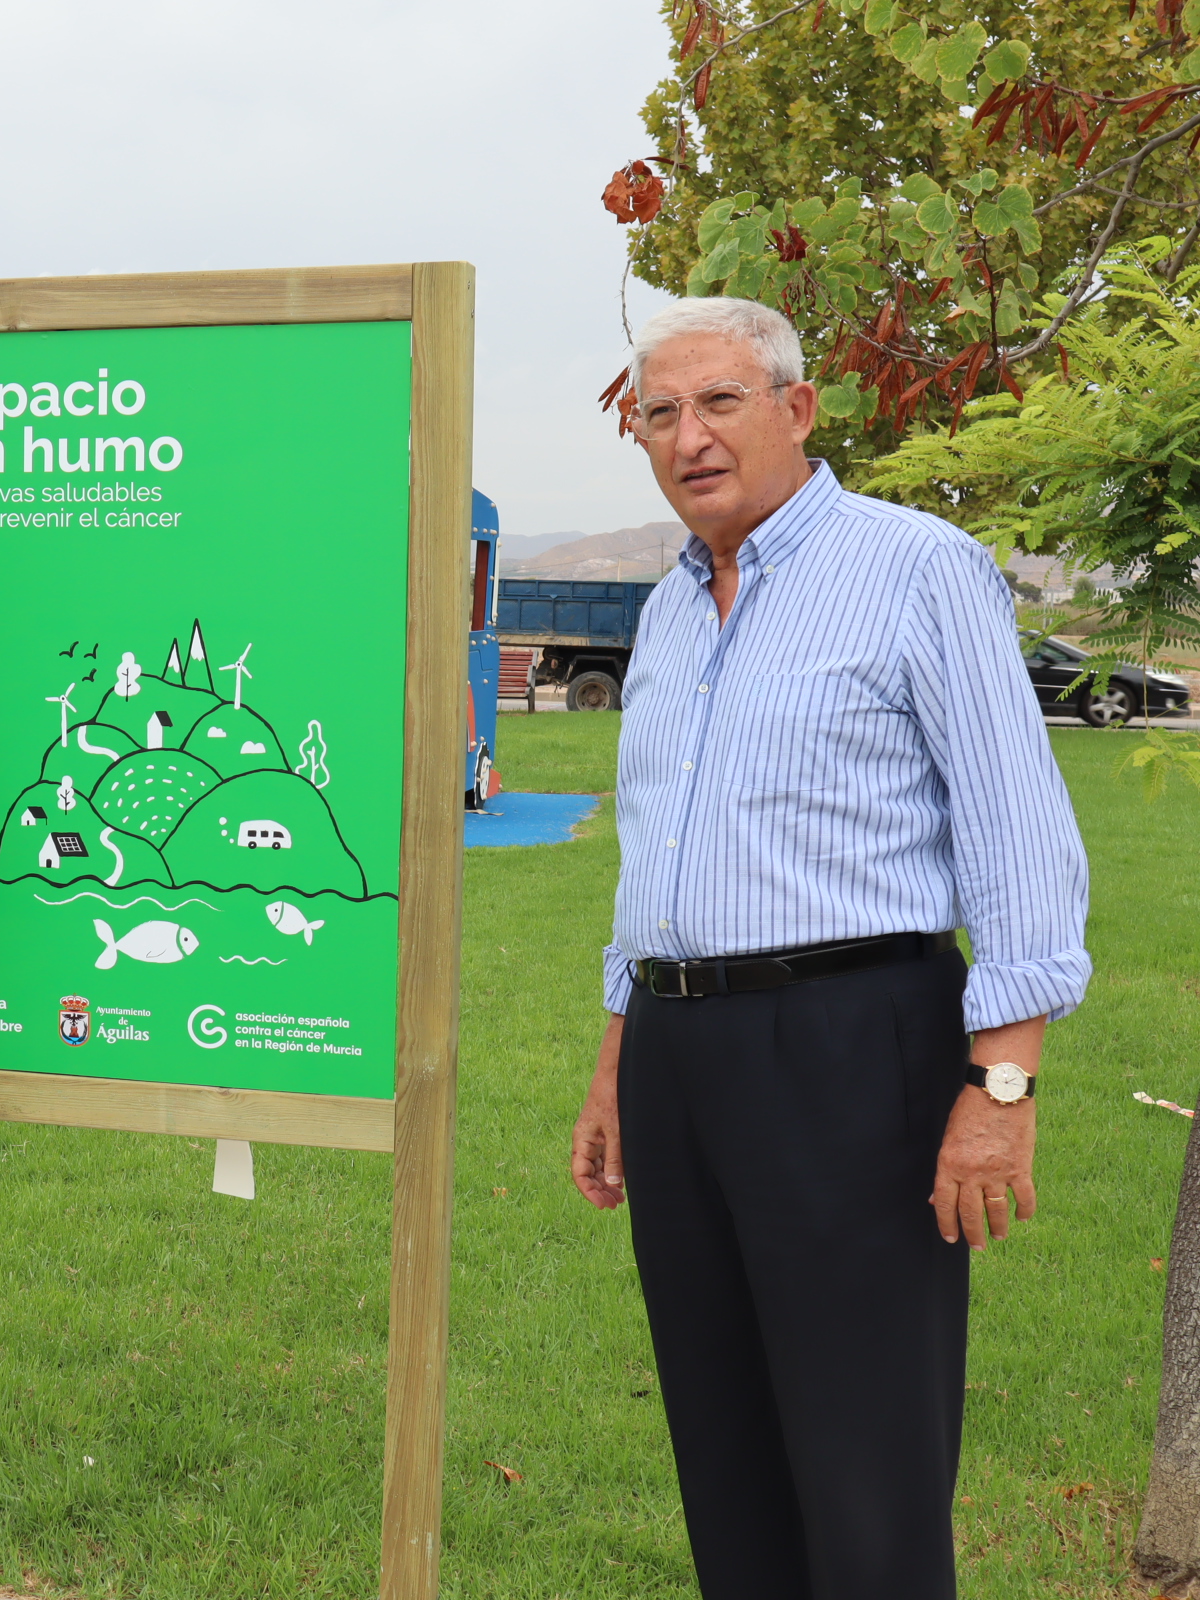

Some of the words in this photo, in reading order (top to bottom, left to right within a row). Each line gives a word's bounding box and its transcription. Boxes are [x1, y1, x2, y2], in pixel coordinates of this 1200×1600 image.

[23, 426, 183, 473] humo
[41, 482, 162, 502] saludables
[79, 508, 99, 528] el
[104, 507, 182, 528] cáncer
[96, 1006, 152, 1018] Ayuntamiento
[118, 1016, 130, 1026] de
[235, 1012, 295, 1025] asociación
[298, 1016, 350, 1029] española
[96, 1023, 150, 1044] Águilas
[235, 1025, 272, 1036] contra
[274, 1026, 285, 1037] el
[287, 1026, 326, 1040] cáncer
[235, 1039, 249, 1048] en
[251, 1038, 262, 1049] la
[264, 1039, 303, 1053] Región
[306, 1042, 321, 1053] de
[323, 1043, 362, 1056] Murcia
